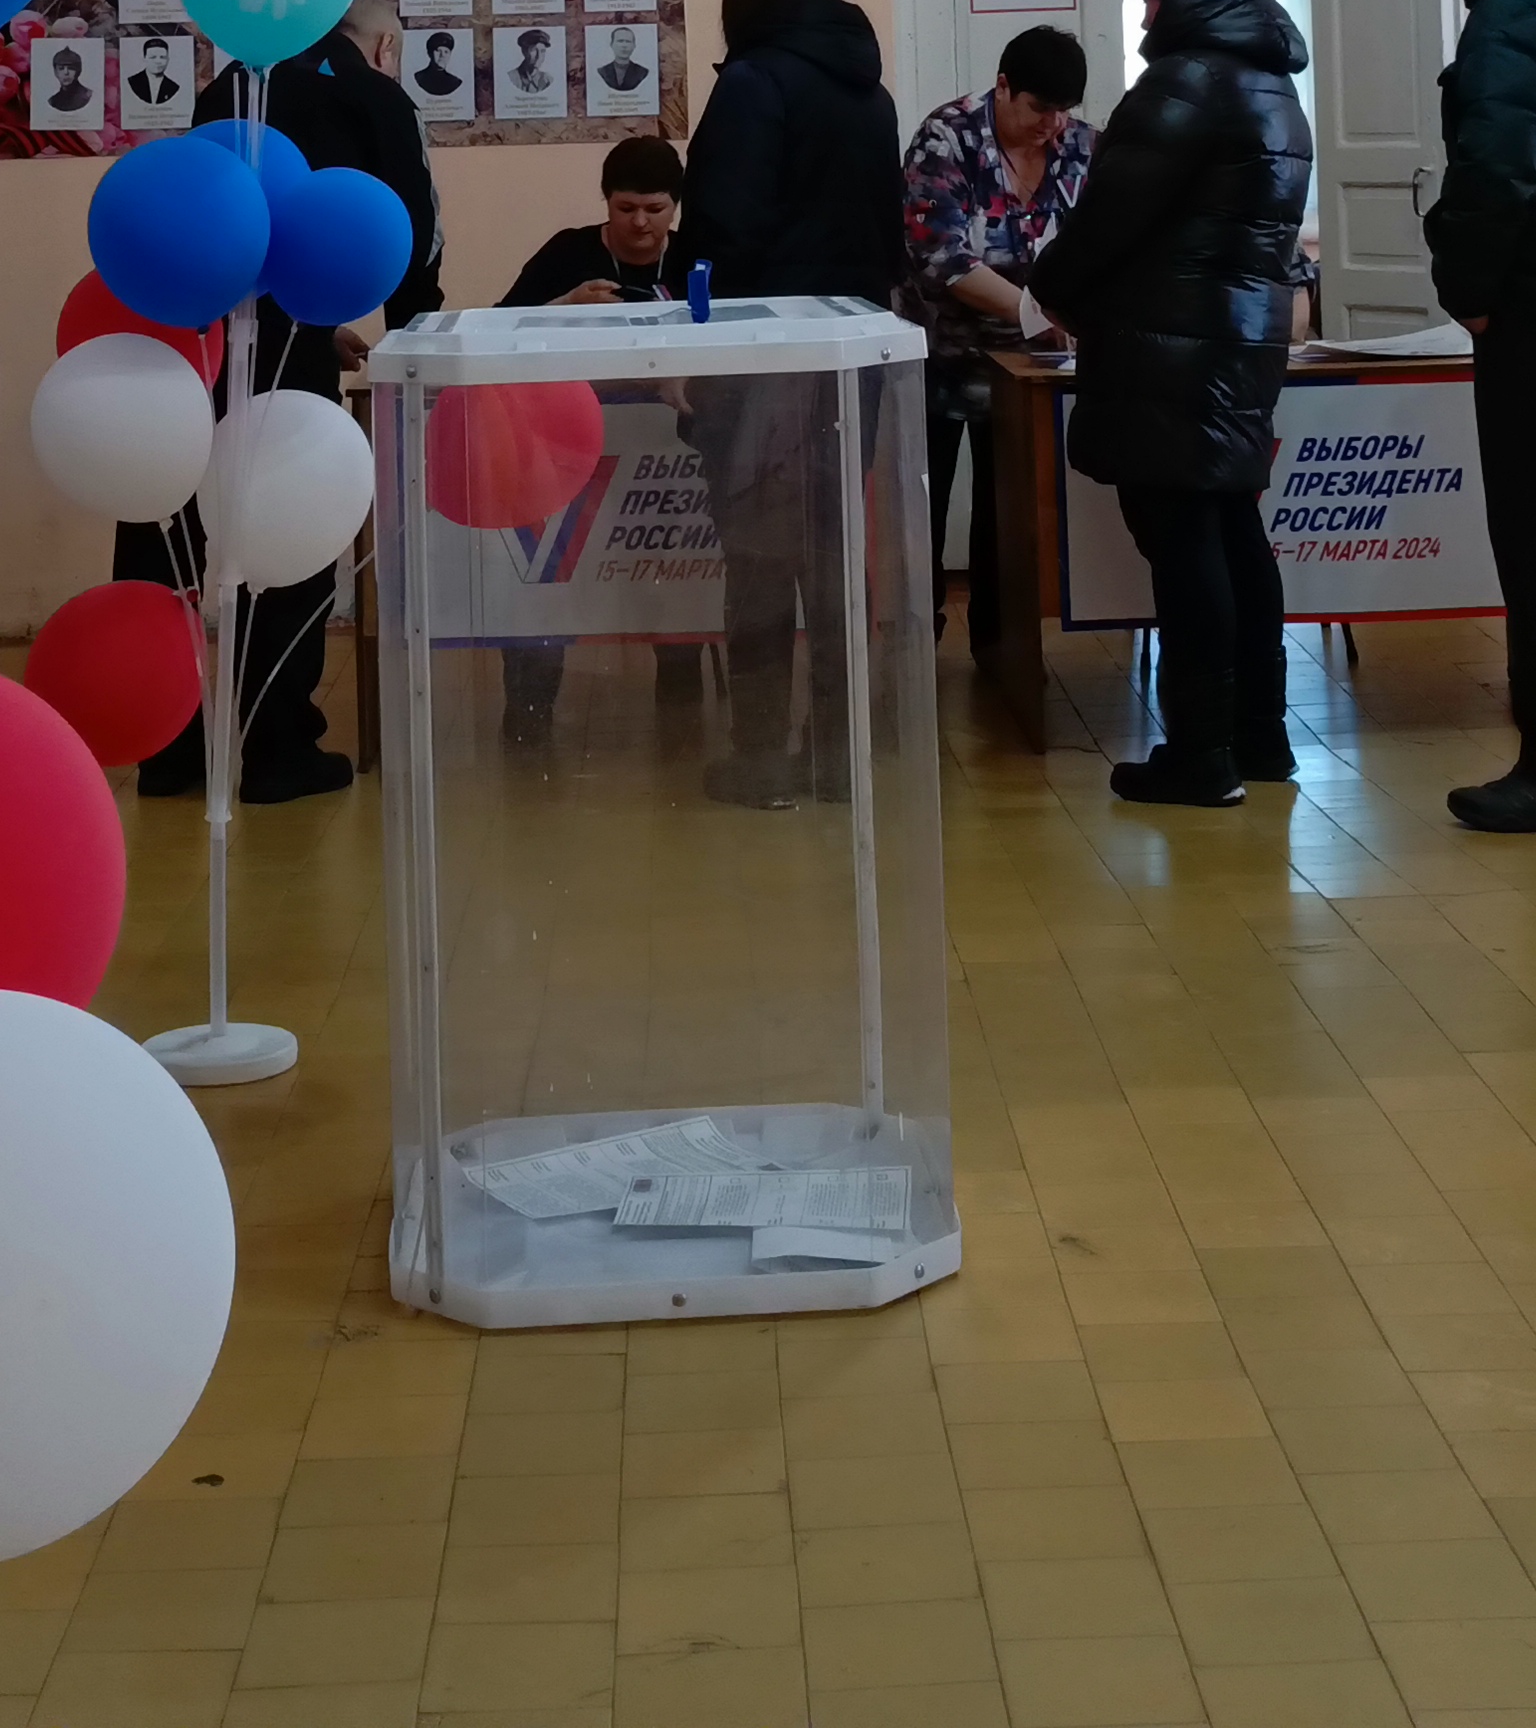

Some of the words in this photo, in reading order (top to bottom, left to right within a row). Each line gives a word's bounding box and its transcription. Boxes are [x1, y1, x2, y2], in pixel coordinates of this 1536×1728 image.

[1296, 434, 1425, 462] ВЫБОРЫ
[633, 454, 705, 480] ВЫБ
[1282, 467, 1463, 499] ПРЕЗИДЕНТА
[619, 489, 711, 515] ПРЕЗИ
[1270, 505, 1388, 533] РОССИИ
[1271, 541, 1317, 562] 5–17
[1319, 539, 1389, 562] МАРТА
[1391, 536, 1441, 560] 2024
[654, 559, 725, 581] МАРТА
